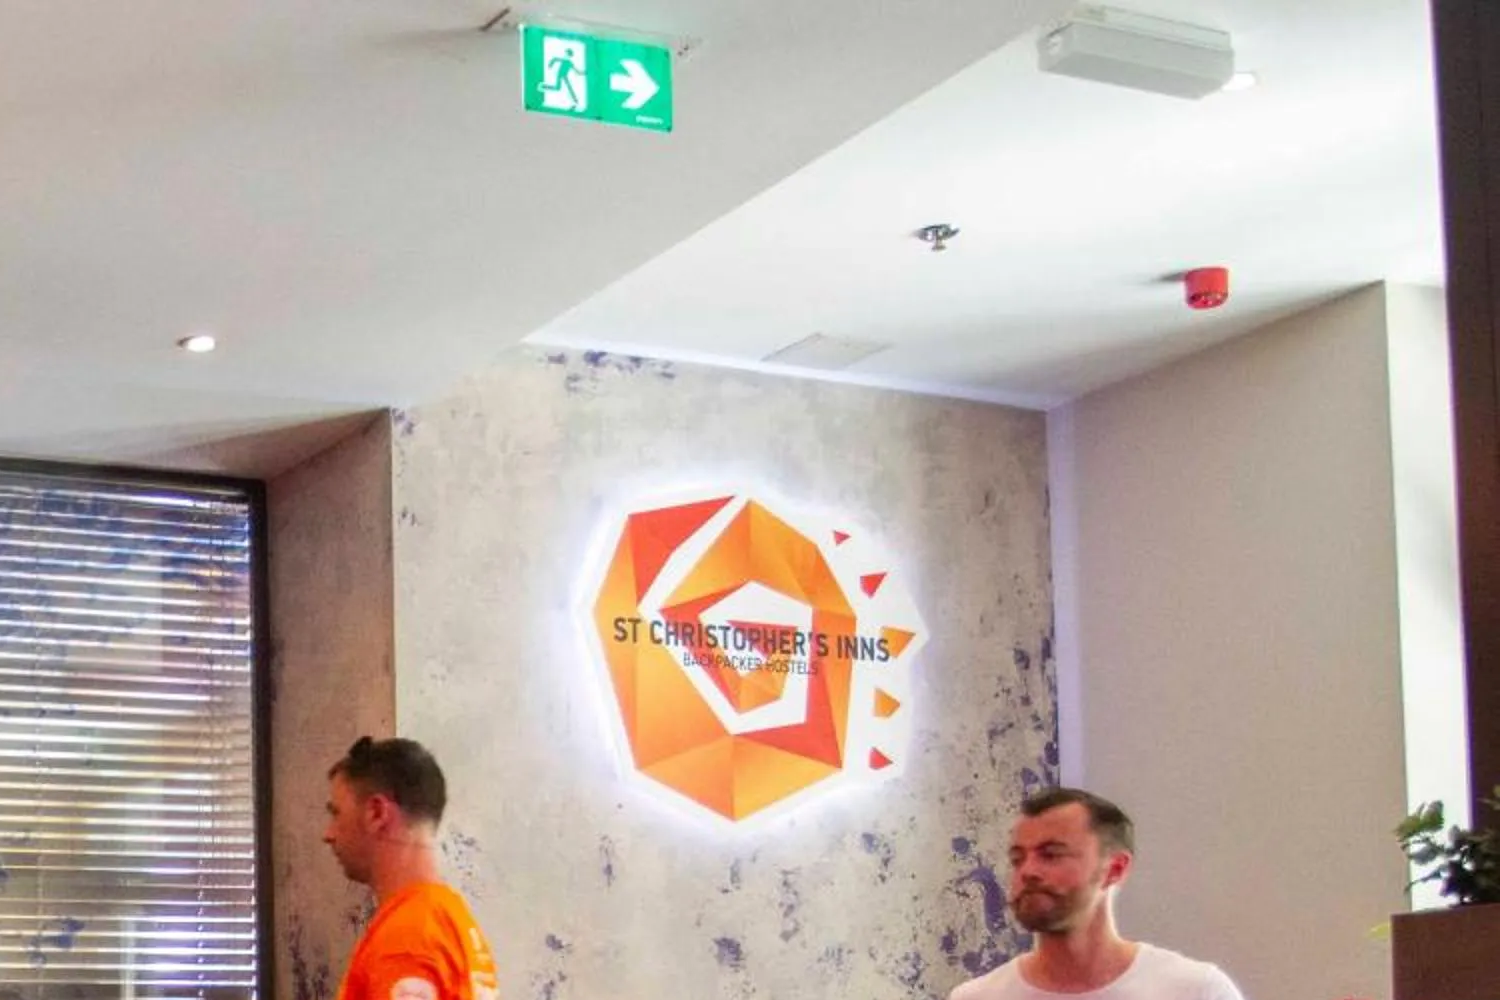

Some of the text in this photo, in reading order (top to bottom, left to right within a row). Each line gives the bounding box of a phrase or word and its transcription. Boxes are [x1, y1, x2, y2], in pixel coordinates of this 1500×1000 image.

[613, 616, 890, 662] ST CHRISTOPHER'S INNS
